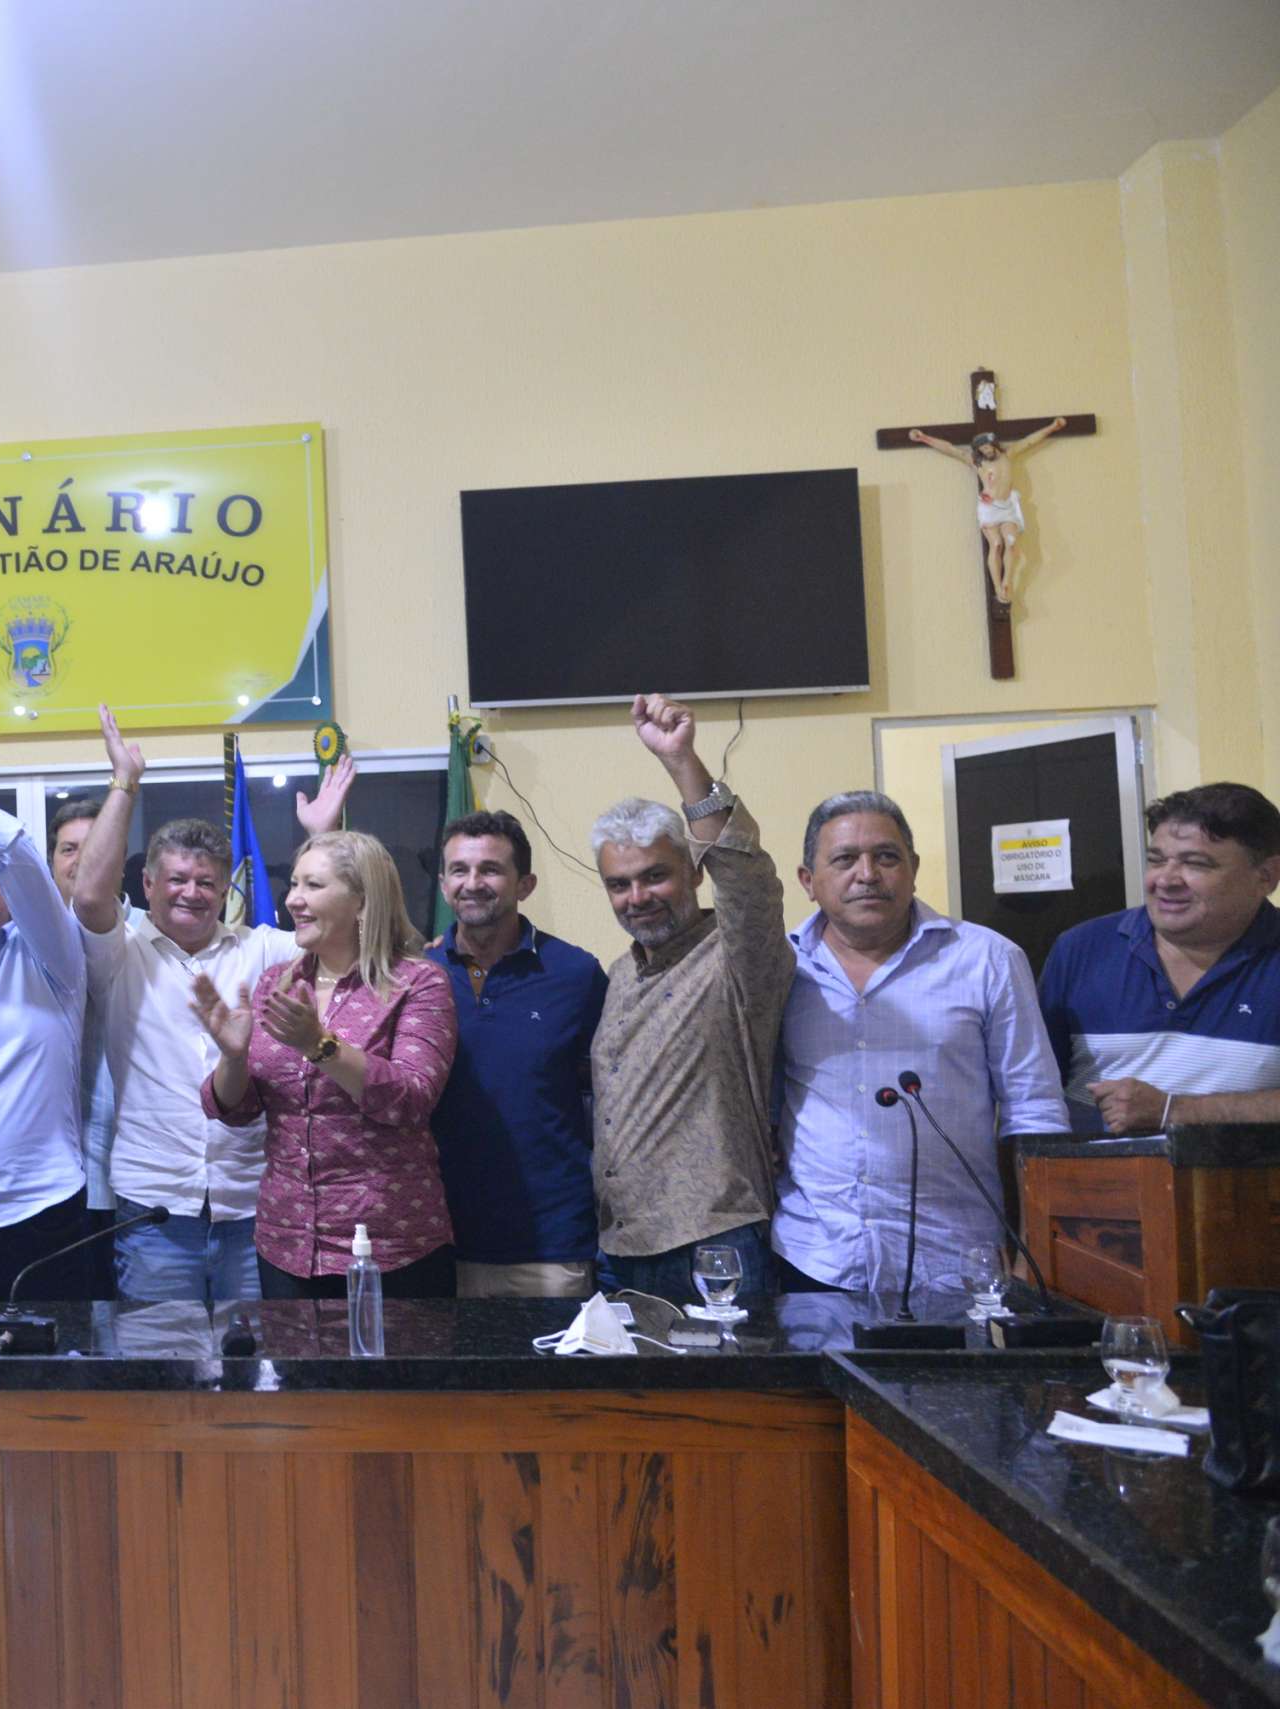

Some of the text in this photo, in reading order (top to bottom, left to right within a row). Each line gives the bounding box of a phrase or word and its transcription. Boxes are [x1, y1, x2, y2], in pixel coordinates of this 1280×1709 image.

[79, 549, 120, 571] DE
[130, 551, 265, 587] ARAÚJO
[1021, 840, 1048, 849] AVISO
[1016, 863, 1033, 871] USO
